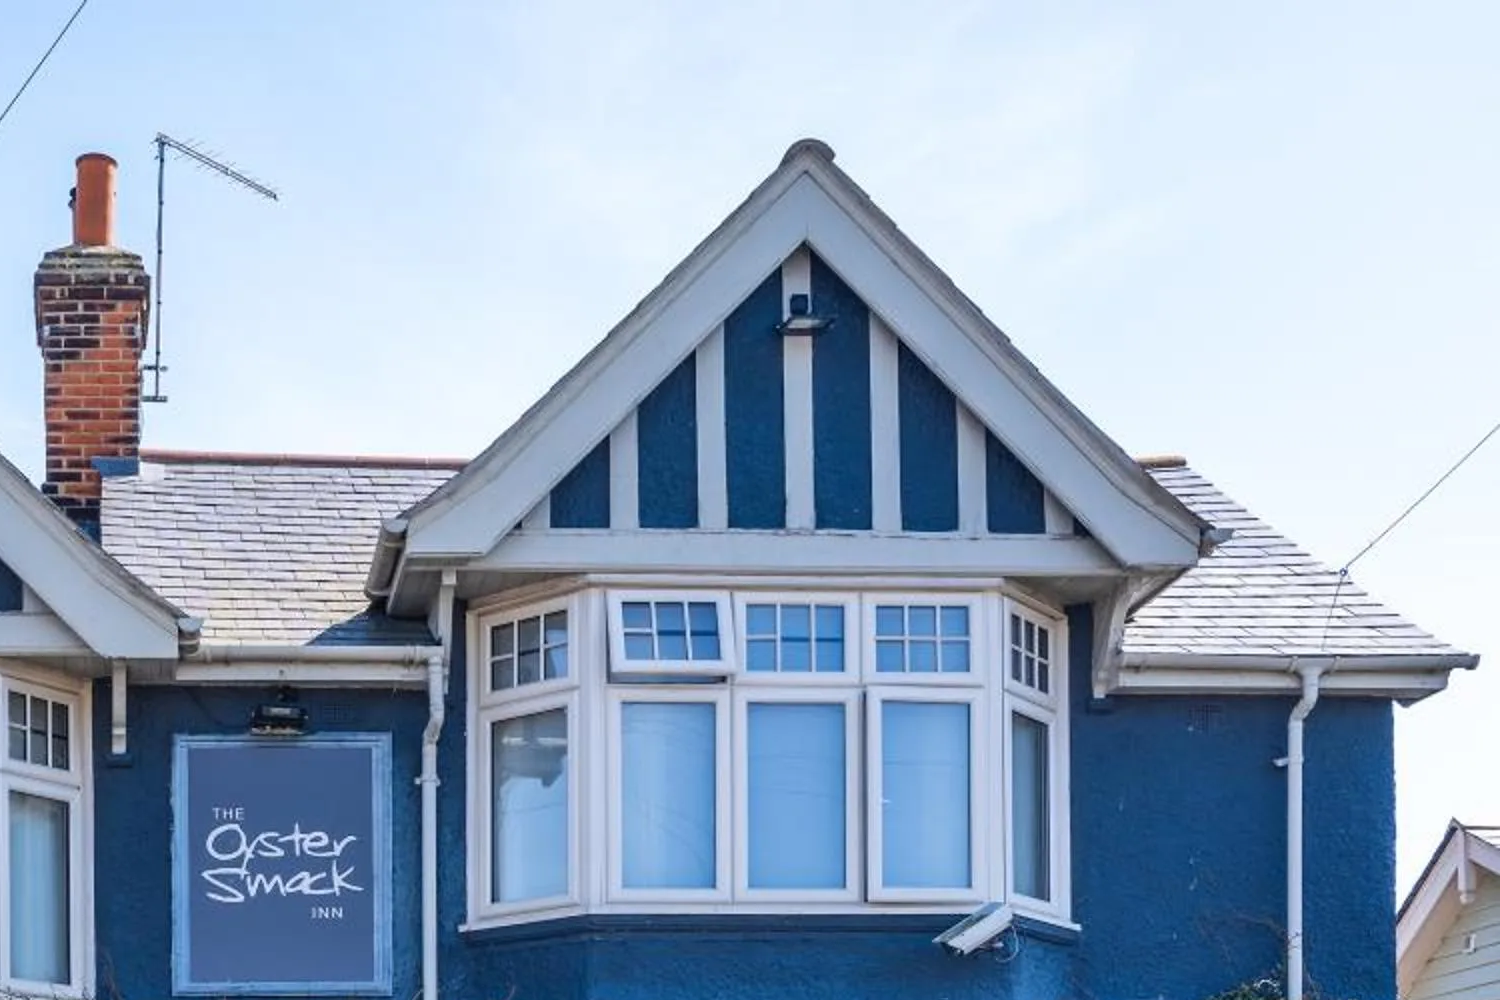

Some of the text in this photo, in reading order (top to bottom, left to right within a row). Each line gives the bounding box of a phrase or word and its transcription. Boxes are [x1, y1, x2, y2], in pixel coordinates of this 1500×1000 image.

[212, 807, 245, 821] THE
[206, 822, 357, 878] Oyster
[201, 860, 364, 903] Smack
[311, 907, 344, 919] INN
